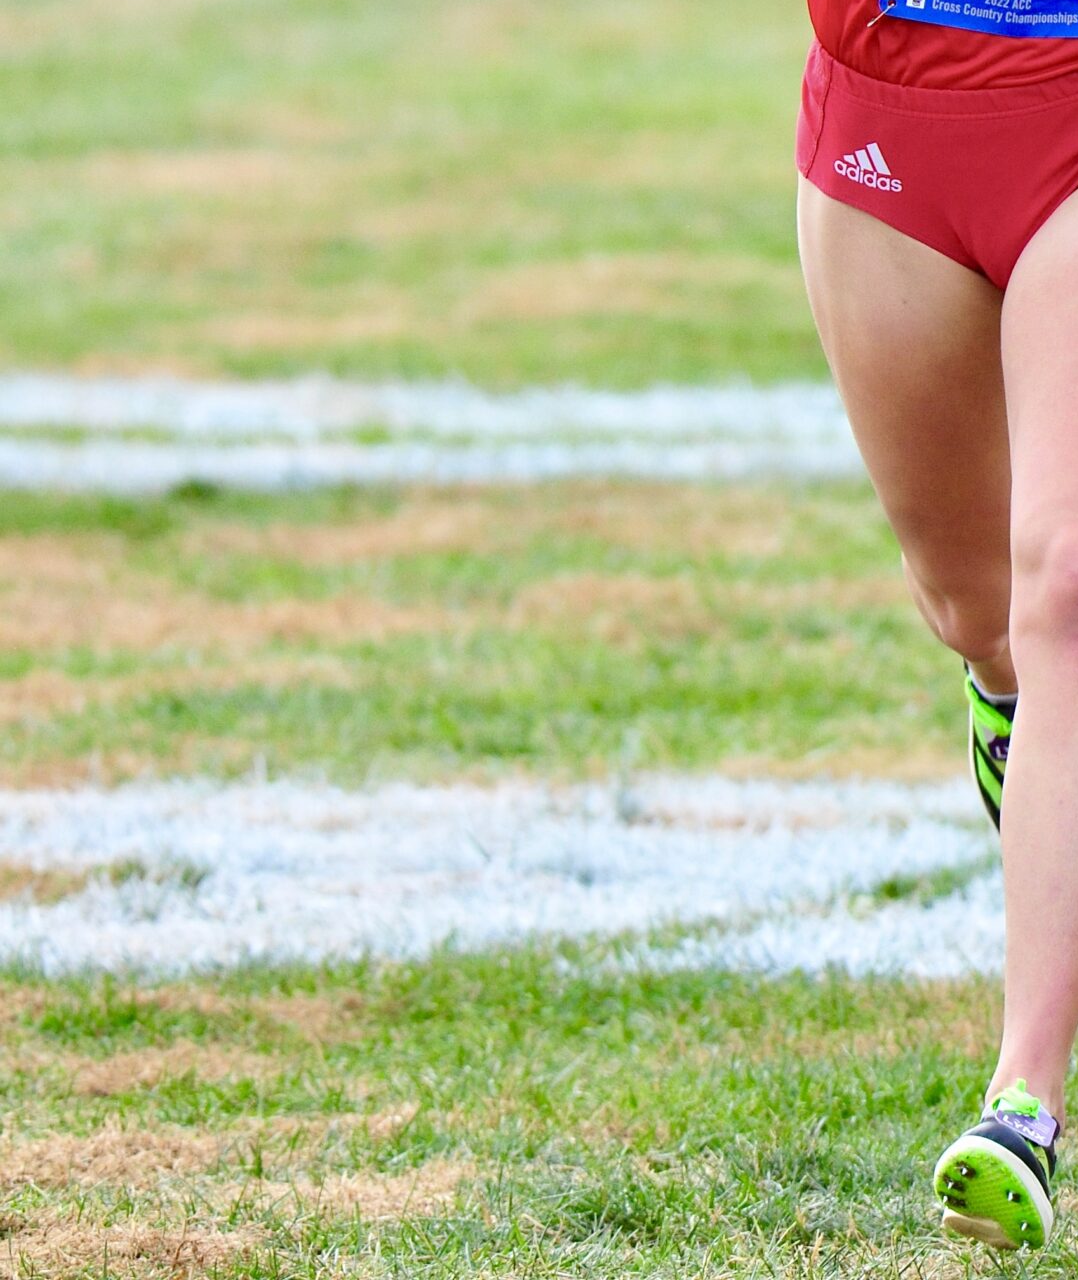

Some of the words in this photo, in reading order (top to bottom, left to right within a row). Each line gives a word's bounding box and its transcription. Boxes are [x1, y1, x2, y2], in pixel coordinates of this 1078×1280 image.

[963, 3, 1003, 23] Country
[1005, 11, 1078, 26] Championships
[834, 160, 903, 193] adidas
